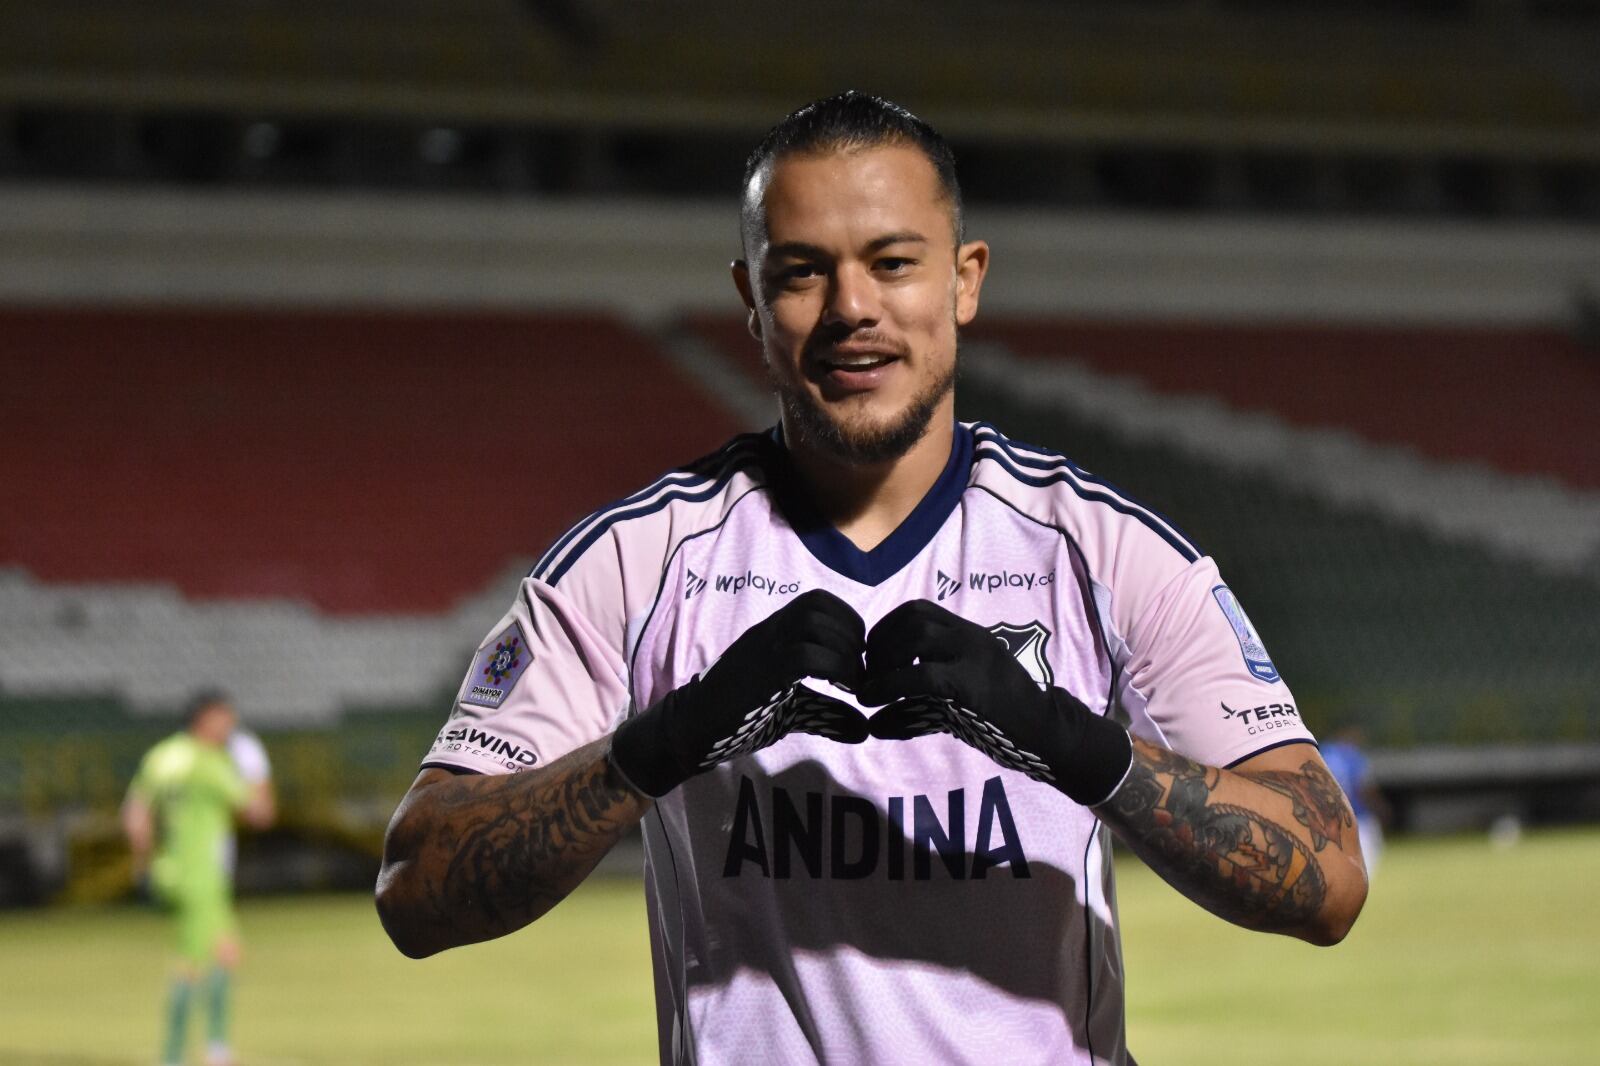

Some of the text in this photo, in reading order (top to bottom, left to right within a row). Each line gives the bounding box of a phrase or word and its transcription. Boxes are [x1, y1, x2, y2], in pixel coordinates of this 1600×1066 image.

[716, 570, 799, 595] wplay.co
[472, 687, 502, 697] DIMAYOR
[1248, 719, 1296, 735] GLOBAL
[722, 774, 1032, 880] ANDINA
